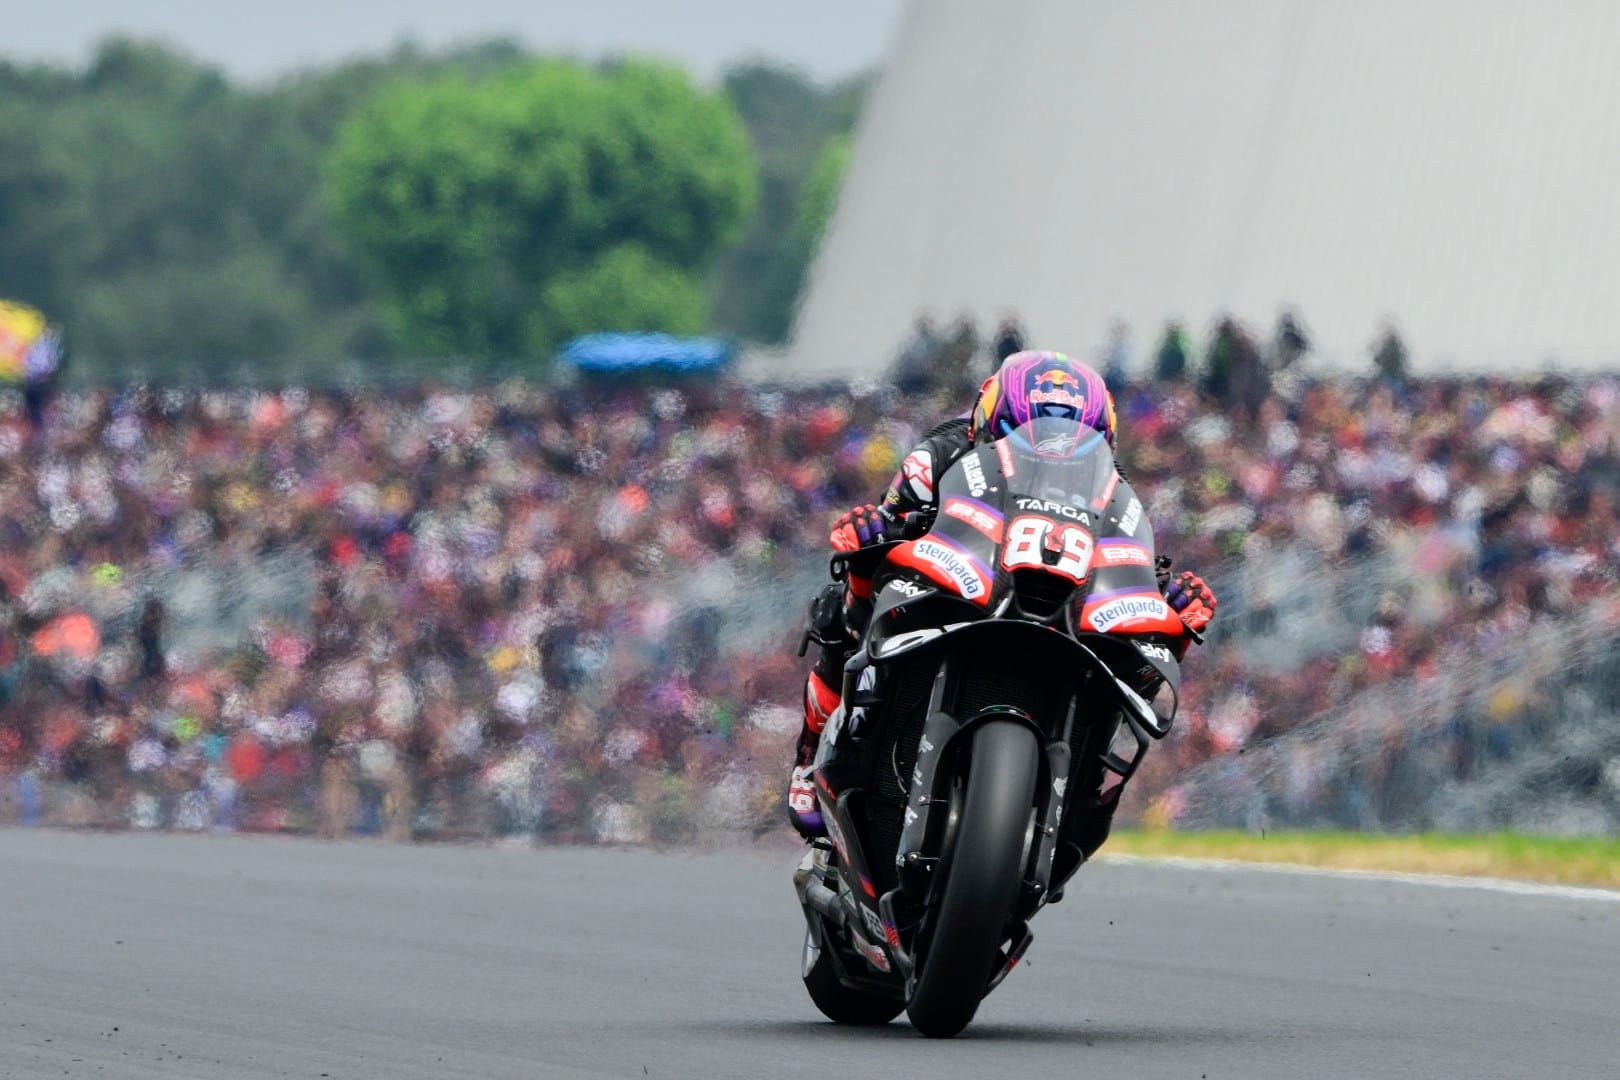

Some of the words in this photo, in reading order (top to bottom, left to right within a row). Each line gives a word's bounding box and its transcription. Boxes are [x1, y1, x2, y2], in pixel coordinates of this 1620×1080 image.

[1030, 389, 1059, 403] Red
[1059, 389, 1084, 408] Bull
[1016, 499, 1090, 526] TARGA
[1003, 516, 1094, 581] 89
[918, 542, 979, 594] sterilgarda
[889, 579, 927, 597] sky
[1094, 600, 1163, 627] sterilgarda
[1140, 643, 1169, 662] sky
